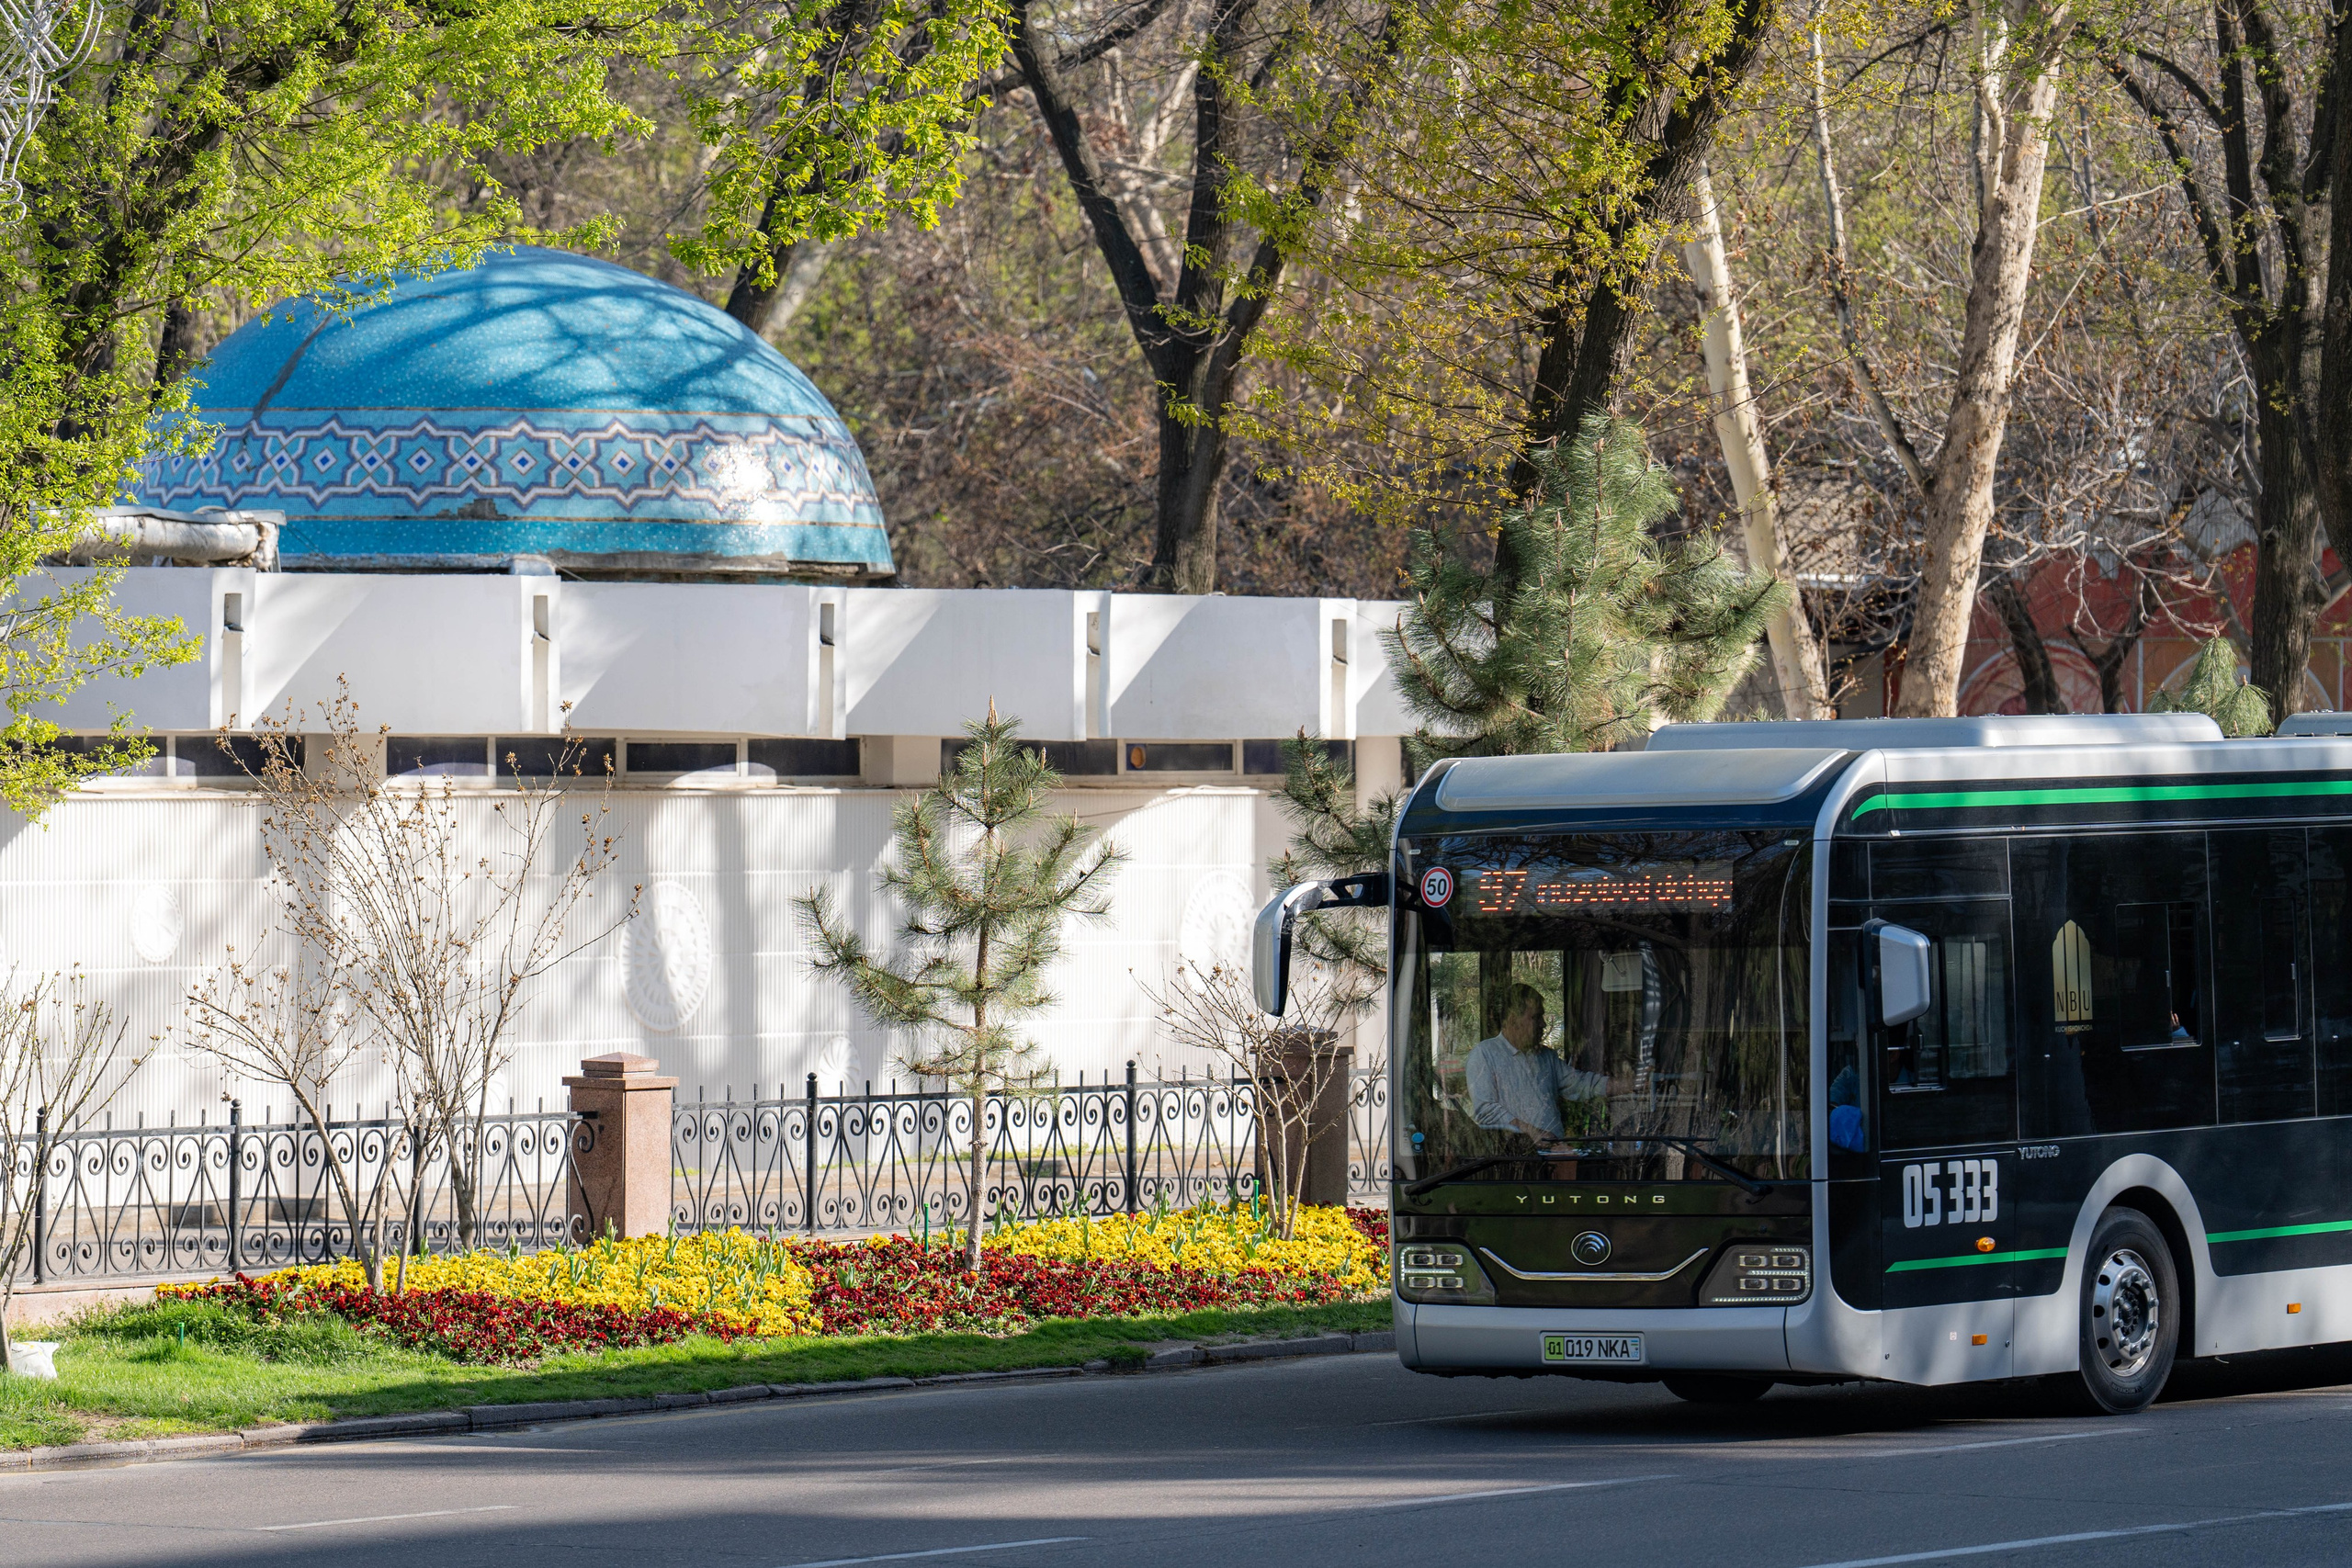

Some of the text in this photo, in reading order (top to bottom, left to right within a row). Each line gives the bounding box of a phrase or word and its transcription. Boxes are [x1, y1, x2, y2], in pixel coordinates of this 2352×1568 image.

[1426, 878, 1447, 896] 50
[2056, 990, 2091, 1013] NBU
[2018, 1145, 2060, 1160] YUTONG
[1516, 1195, 1665, 1203] YUTONG
[1549, 1341, 1563, 1356] 01
[1566, 1339, 1593, 1358] 019
[1598, 1339, 1630, 1358] NKA
